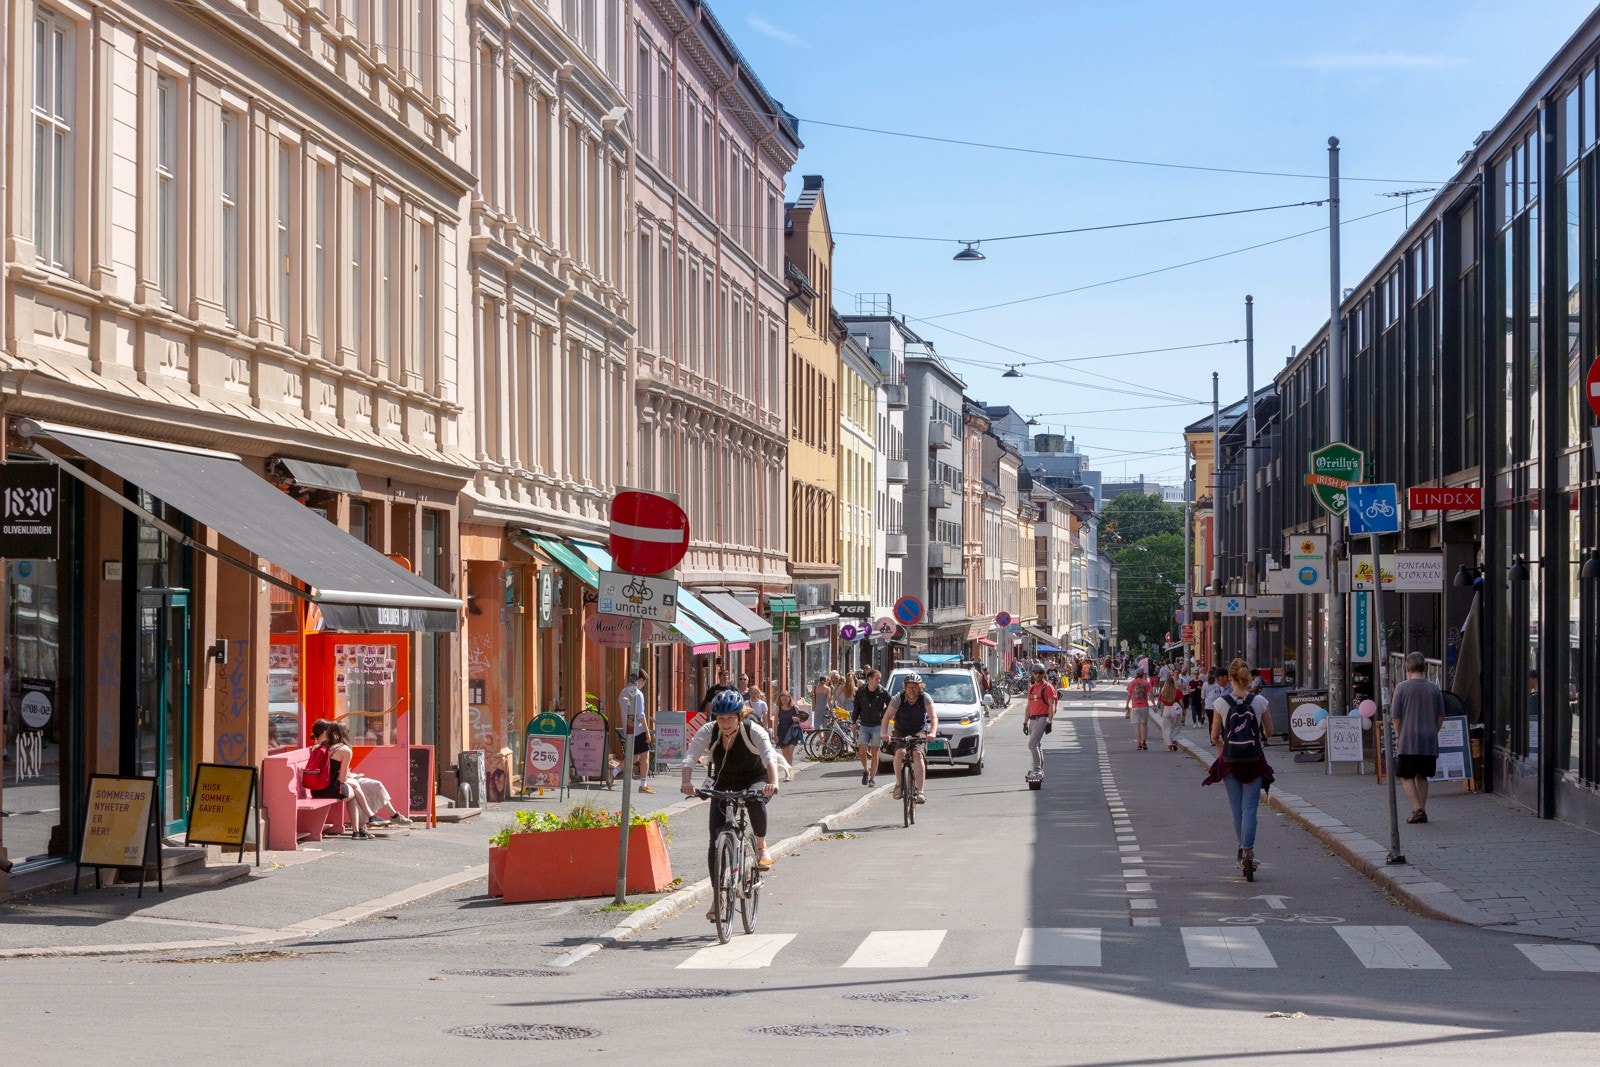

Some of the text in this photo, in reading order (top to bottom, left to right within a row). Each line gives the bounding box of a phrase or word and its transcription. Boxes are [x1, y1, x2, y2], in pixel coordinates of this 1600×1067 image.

[1317, 475, 1338, 487] IRISH
[1415, 493, 1475, 505] LINDEX
[3, 525, 52, 535] OLIVENLUNDEN
[1397, 562, 1441, 570] FONTANAS
[1397, 571, 1441, 580] KJØKKEN
[615, 603, 658, 616] unntatt
[839, 605, 866, 613] TGR
[532, 751, 557, 763] 25%
[202, 783, 221, 791] HUSK
[96, 790, 146, 801] SOMMERENS
[201, 793, 233, 802] SOMMER-
[94, 802, 130, 812] NYHETER
[199, 804, 225, 813] GAVER!
[93, 814, 103, 824] ER
[91, 826, 110, 836] HER!
